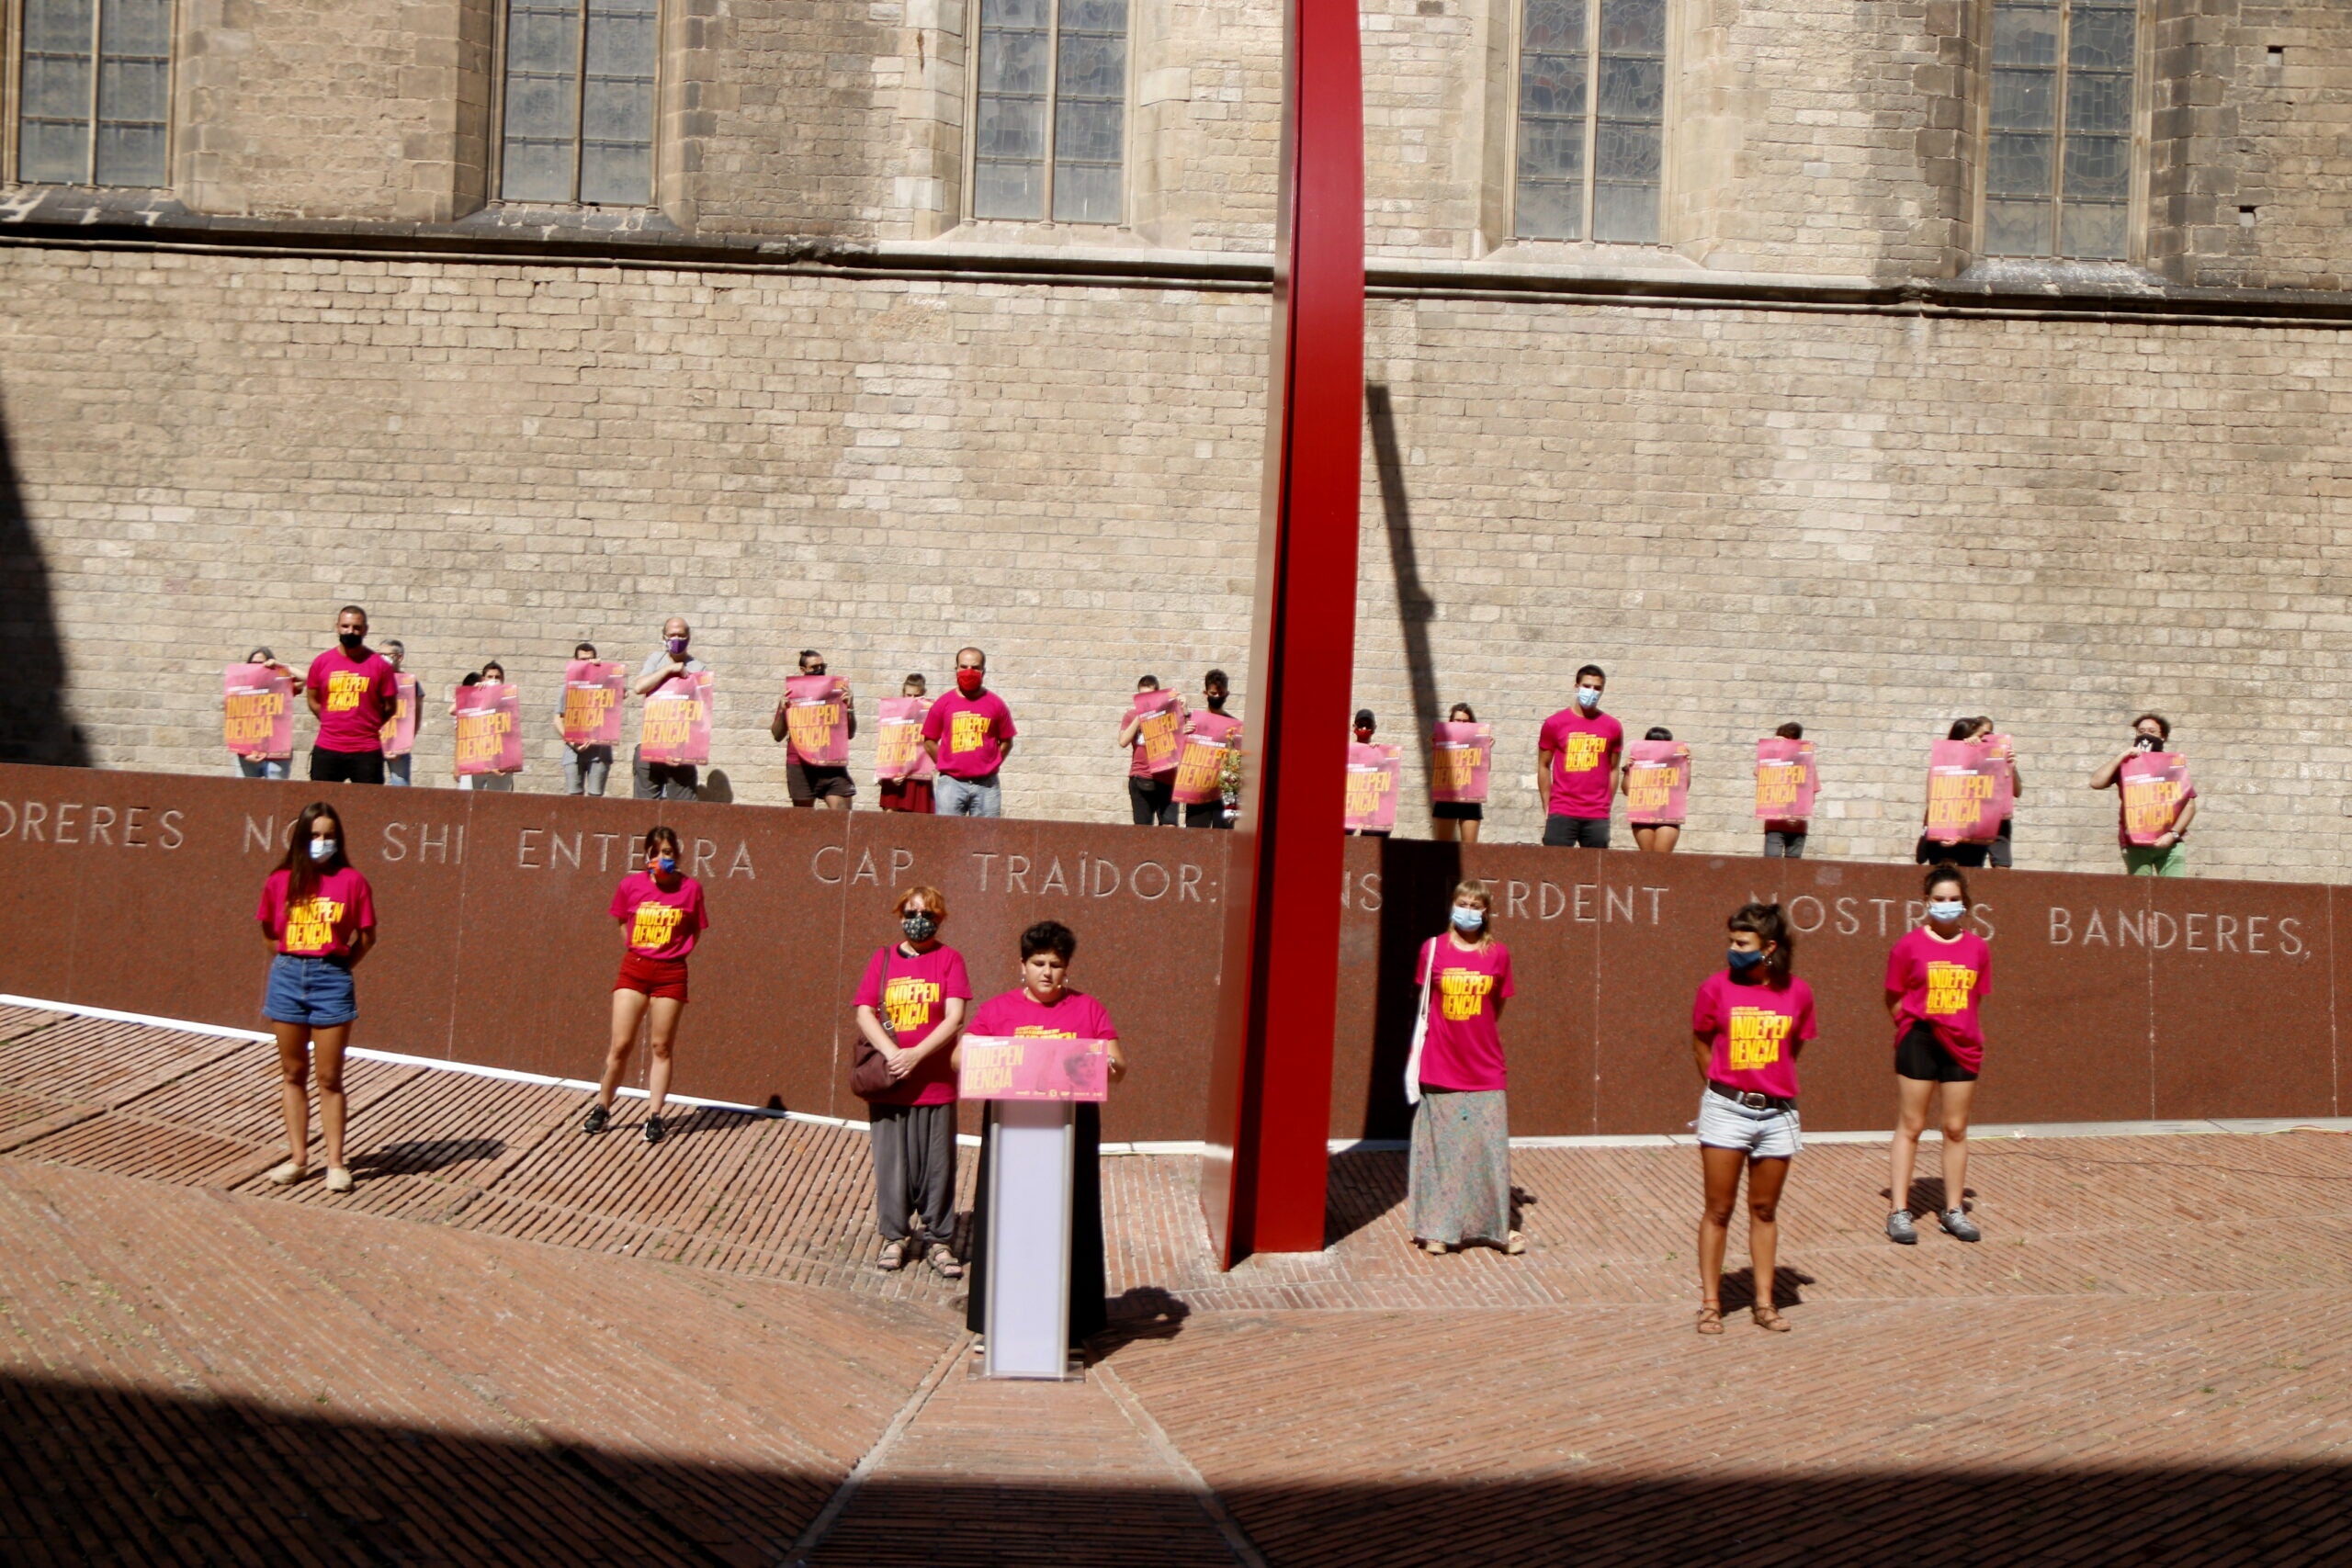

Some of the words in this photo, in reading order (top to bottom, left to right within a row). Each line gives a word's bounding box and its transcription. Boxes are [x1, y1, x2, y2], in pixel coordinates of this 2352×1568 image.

[566, 689, 616, 707] INDEPEN
[564, 706, 604, 727] DENCIA
[645, 700, 704, 721] INDEPEN
[789, 704, 840, 728] INDEPEN
[458, 711, 511, 739] INDEPEN
[642, 720, 690, 743] DENCIA
[457, 733, 503, 759] DENCIA
[876, 742, 917, 764] DENCIA
[1566, 737, 1607, 752] INDEPEN
[1434, 747, 1483, 767] INDEPEN
[1565, 751, 1599, 768] DENCIA
[1346, 772, 1391, 792] NDEPEN
[1433, 766, 1472, 785] DENCIA
[1630, 767, 1679, 788] INDEPEN
[1758, 764, 1807, 786] INDEPEN
[1627, 786, 1669, 807] DENCIA
[1756, 784, 1797, 805] DENCIA
[1930, 774, 1995, 799] INDEPEN
[1345, 792, 1380, 812] ENCIA
[1928, 799, 1981, 822] DENCIA
[518, 828, 756, 879] ENTERA
[811, 843, 914, 887] CAP
[1750, 890, 1996, 942] OSTRS
[2049, 907, 2312, 960] BANDERES,
[287, 922, 333, 945] DENCIA
[632, 924, 673, 944] DENCIA
[885, 982, 940, 1007] INDEPEN
[966, 1044, 1024, 1068] INDEPEN
[965, 1066, 1013, 1091] DENCIA
